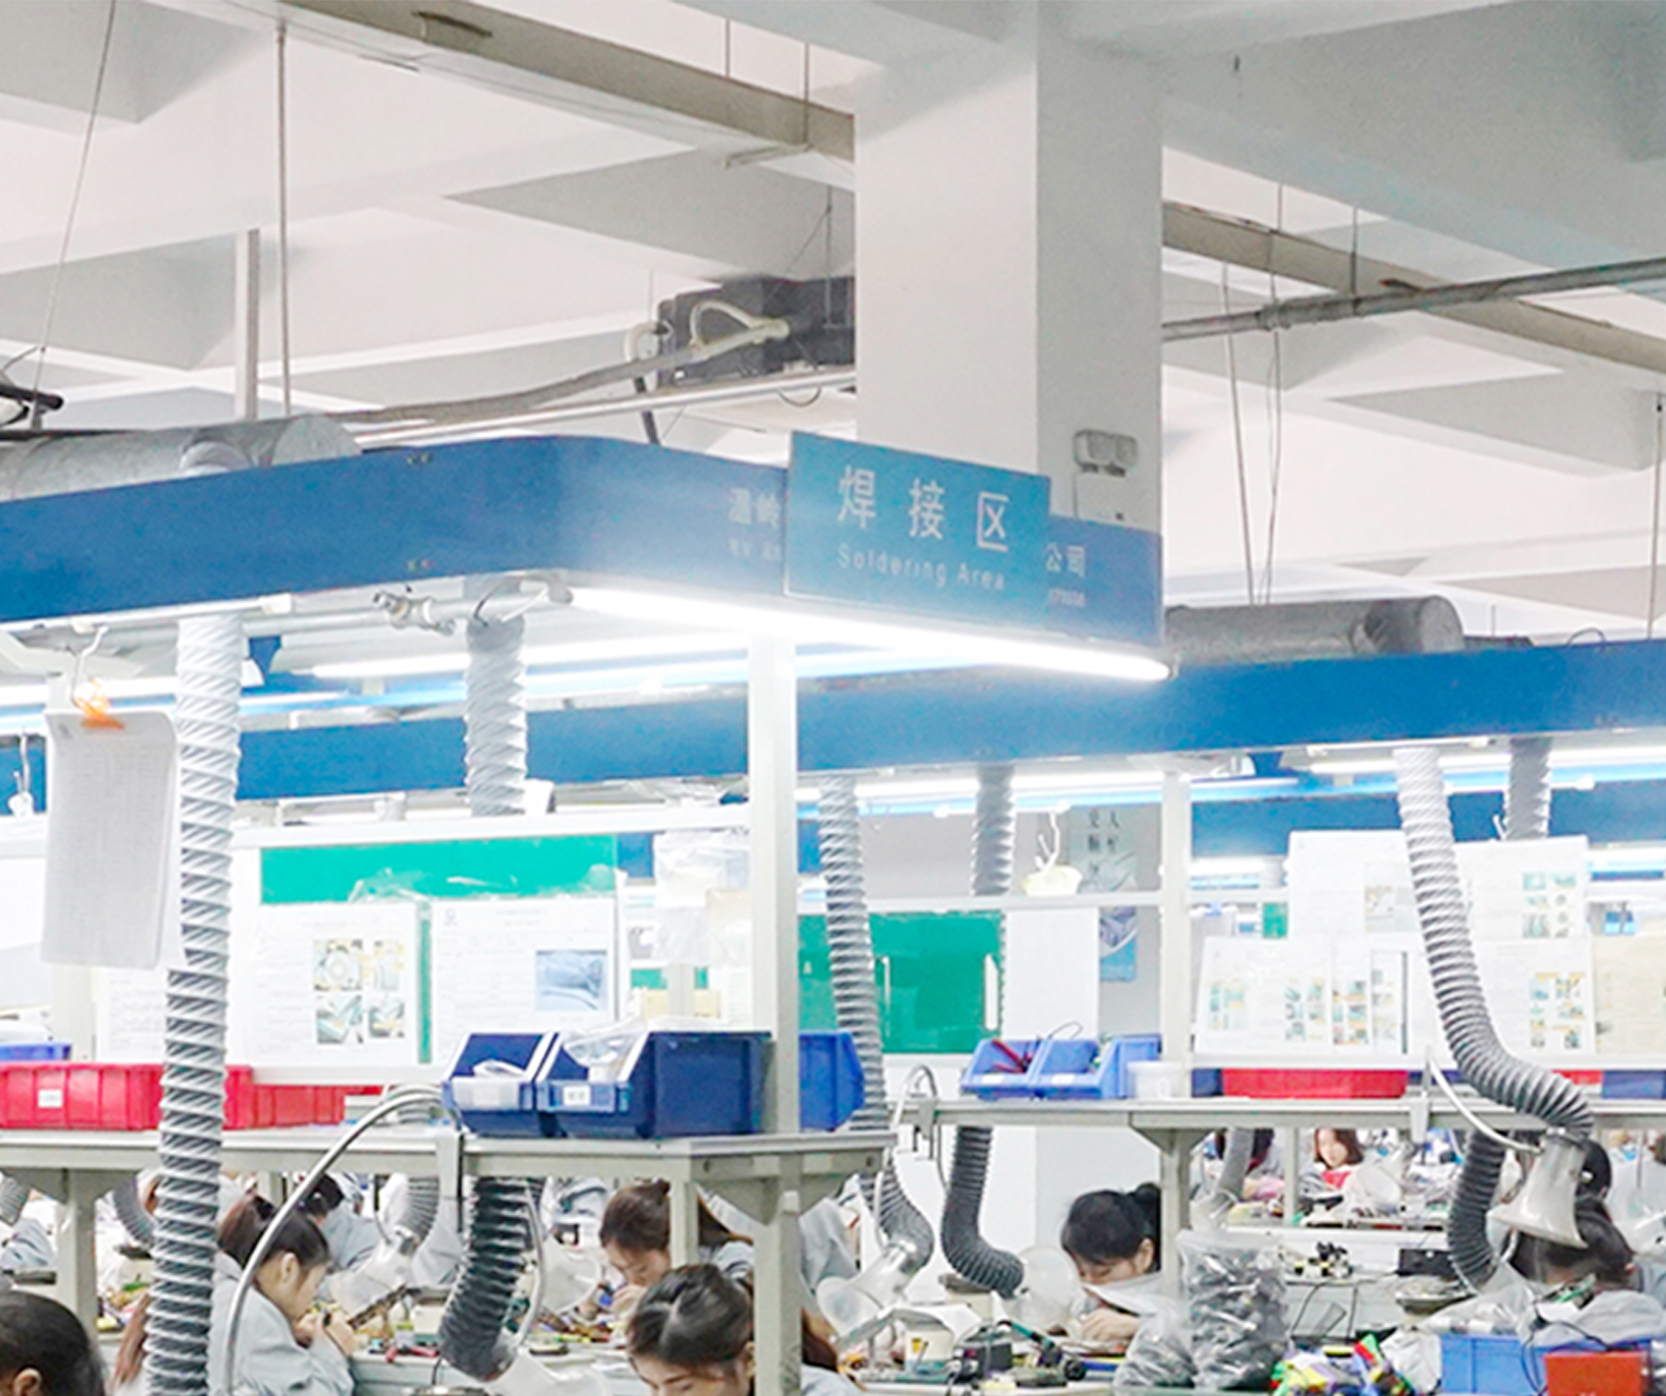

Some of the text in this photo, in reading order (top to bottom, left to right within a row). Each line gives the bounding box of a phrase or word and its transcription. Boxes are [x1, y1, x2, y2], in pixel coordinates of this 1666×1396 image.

[837, 465, 1009, 552] 焊接区
[837, 543, 1005, 590] Soldering Area
